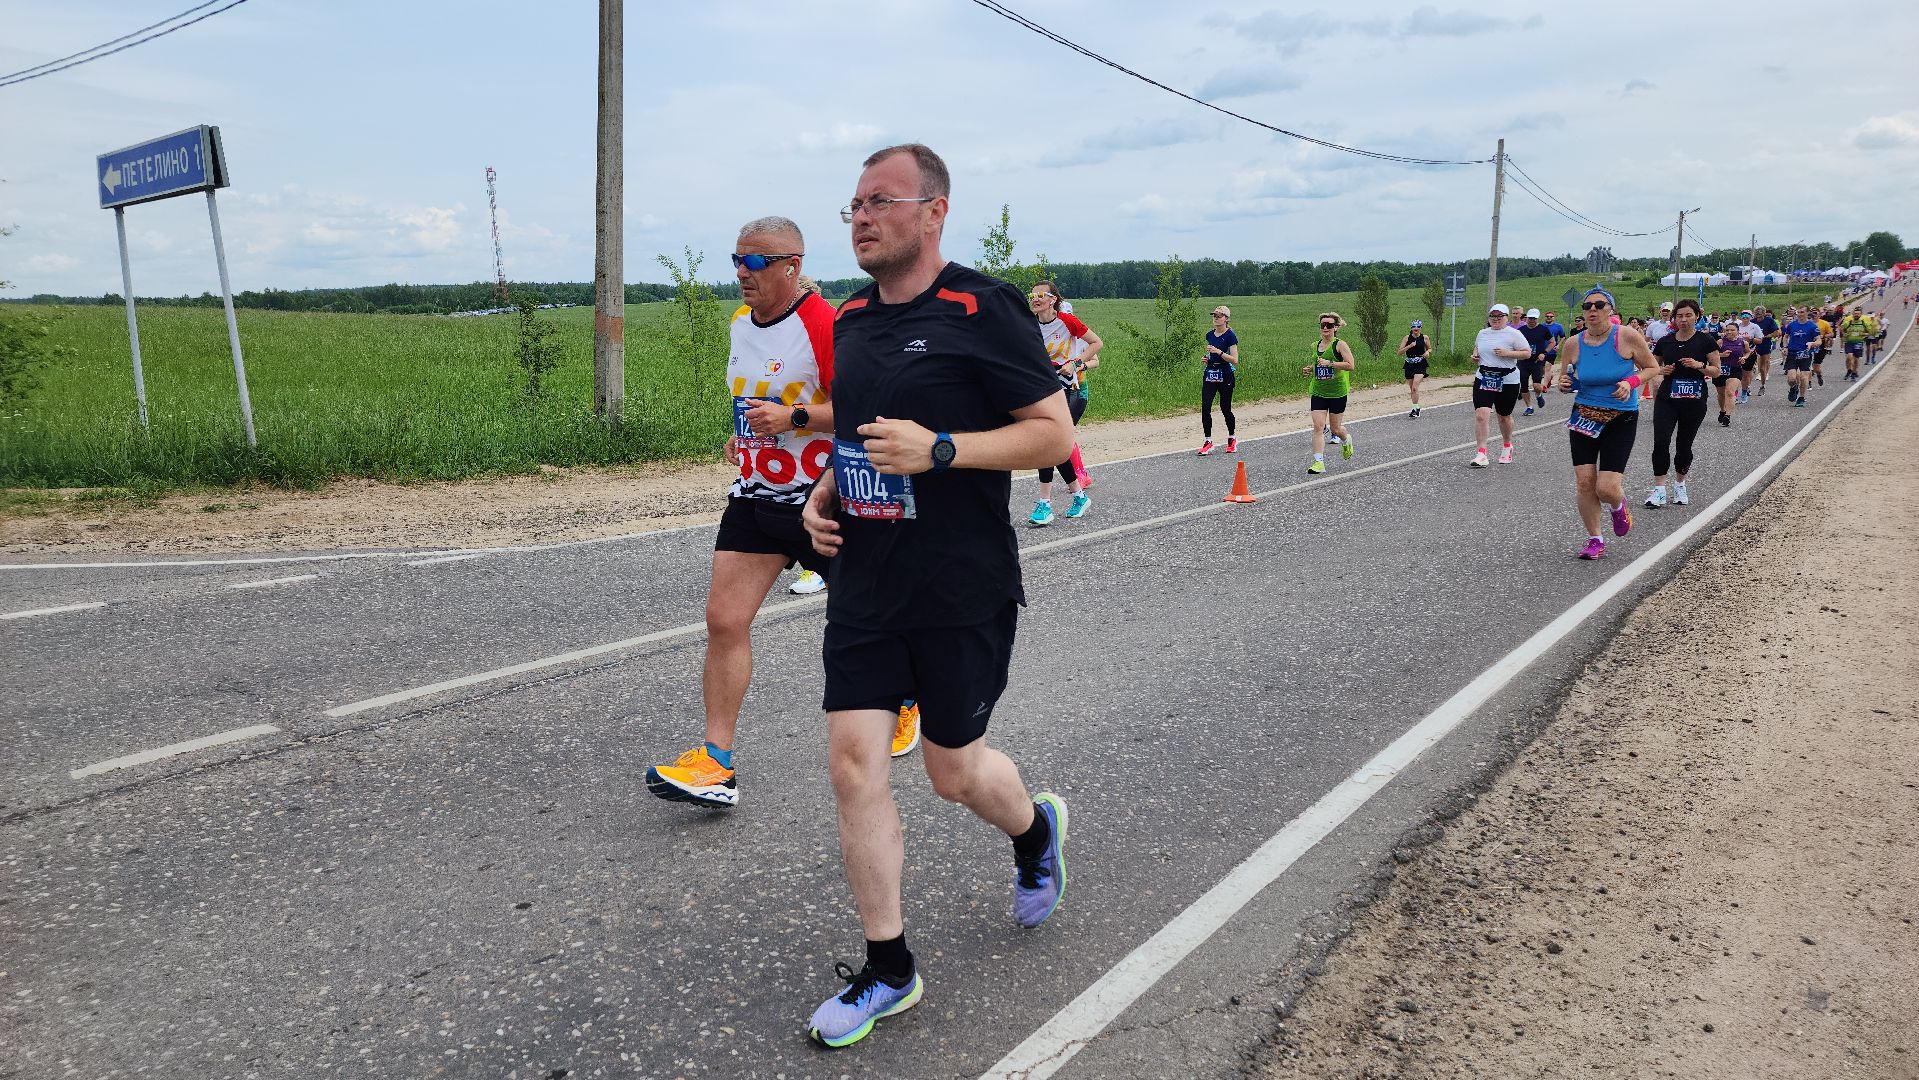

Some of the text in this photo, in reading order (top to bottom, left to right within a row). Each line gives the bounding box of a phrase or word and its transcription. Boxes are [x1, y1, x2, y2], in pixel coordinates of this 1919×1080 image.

[121, 143, 202, 188] ПЕТЕЛИНО 1
[1677, 385, 1694, 395] 1103
[1575, 416, 1597, 431] 1120
[843, 466, 889, 501] 1104
